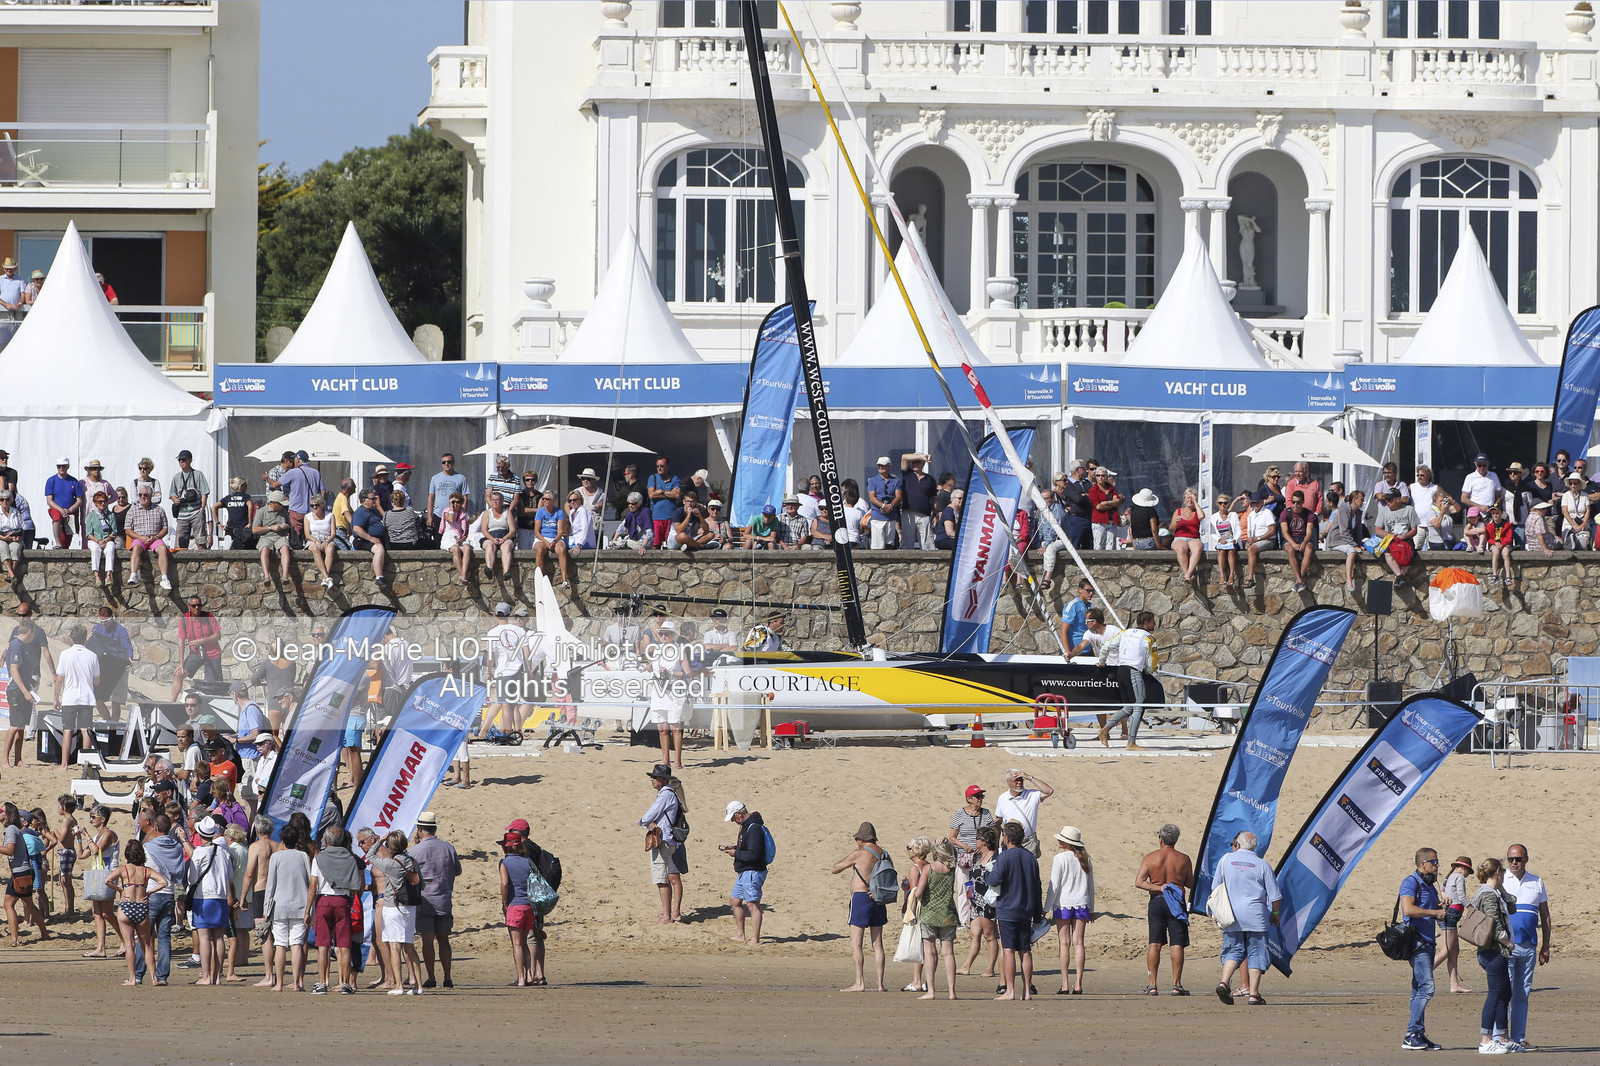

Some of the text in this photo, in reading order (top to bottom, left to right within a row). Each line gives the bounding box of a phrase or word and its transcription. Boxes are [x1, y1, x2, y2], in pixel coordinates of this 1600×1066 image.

[311, 378, 399, 392] YACHT CLUB
[594, 377, 681, 390] YACHT CLUB
[1098, 384, 1119, 392] voile
[1164, 382, 1247, 396] YACHT CLUB
[1375, 383, 1396, 391] voile
[800, 320, 844, 521] www.west-courtage.com
[738, 674, 862, 692] COURTAGE
[1265, 694, 1306, 719] #TourVoile
[1426, 733, 1448, 754] voile
[294, 748, 326, 764] Groupama
[374, 741, 428, 830] YANMAR
[1374, 768, 1402, 794] FINAGAZ
[277, 795, 312, 812] Groupama
[1228, 788, 1270, 813] @TourVoile
[1344, 804, 1371, 832] FINAGAZ
[1317, 844, 1341, 871] FINAGAZ
